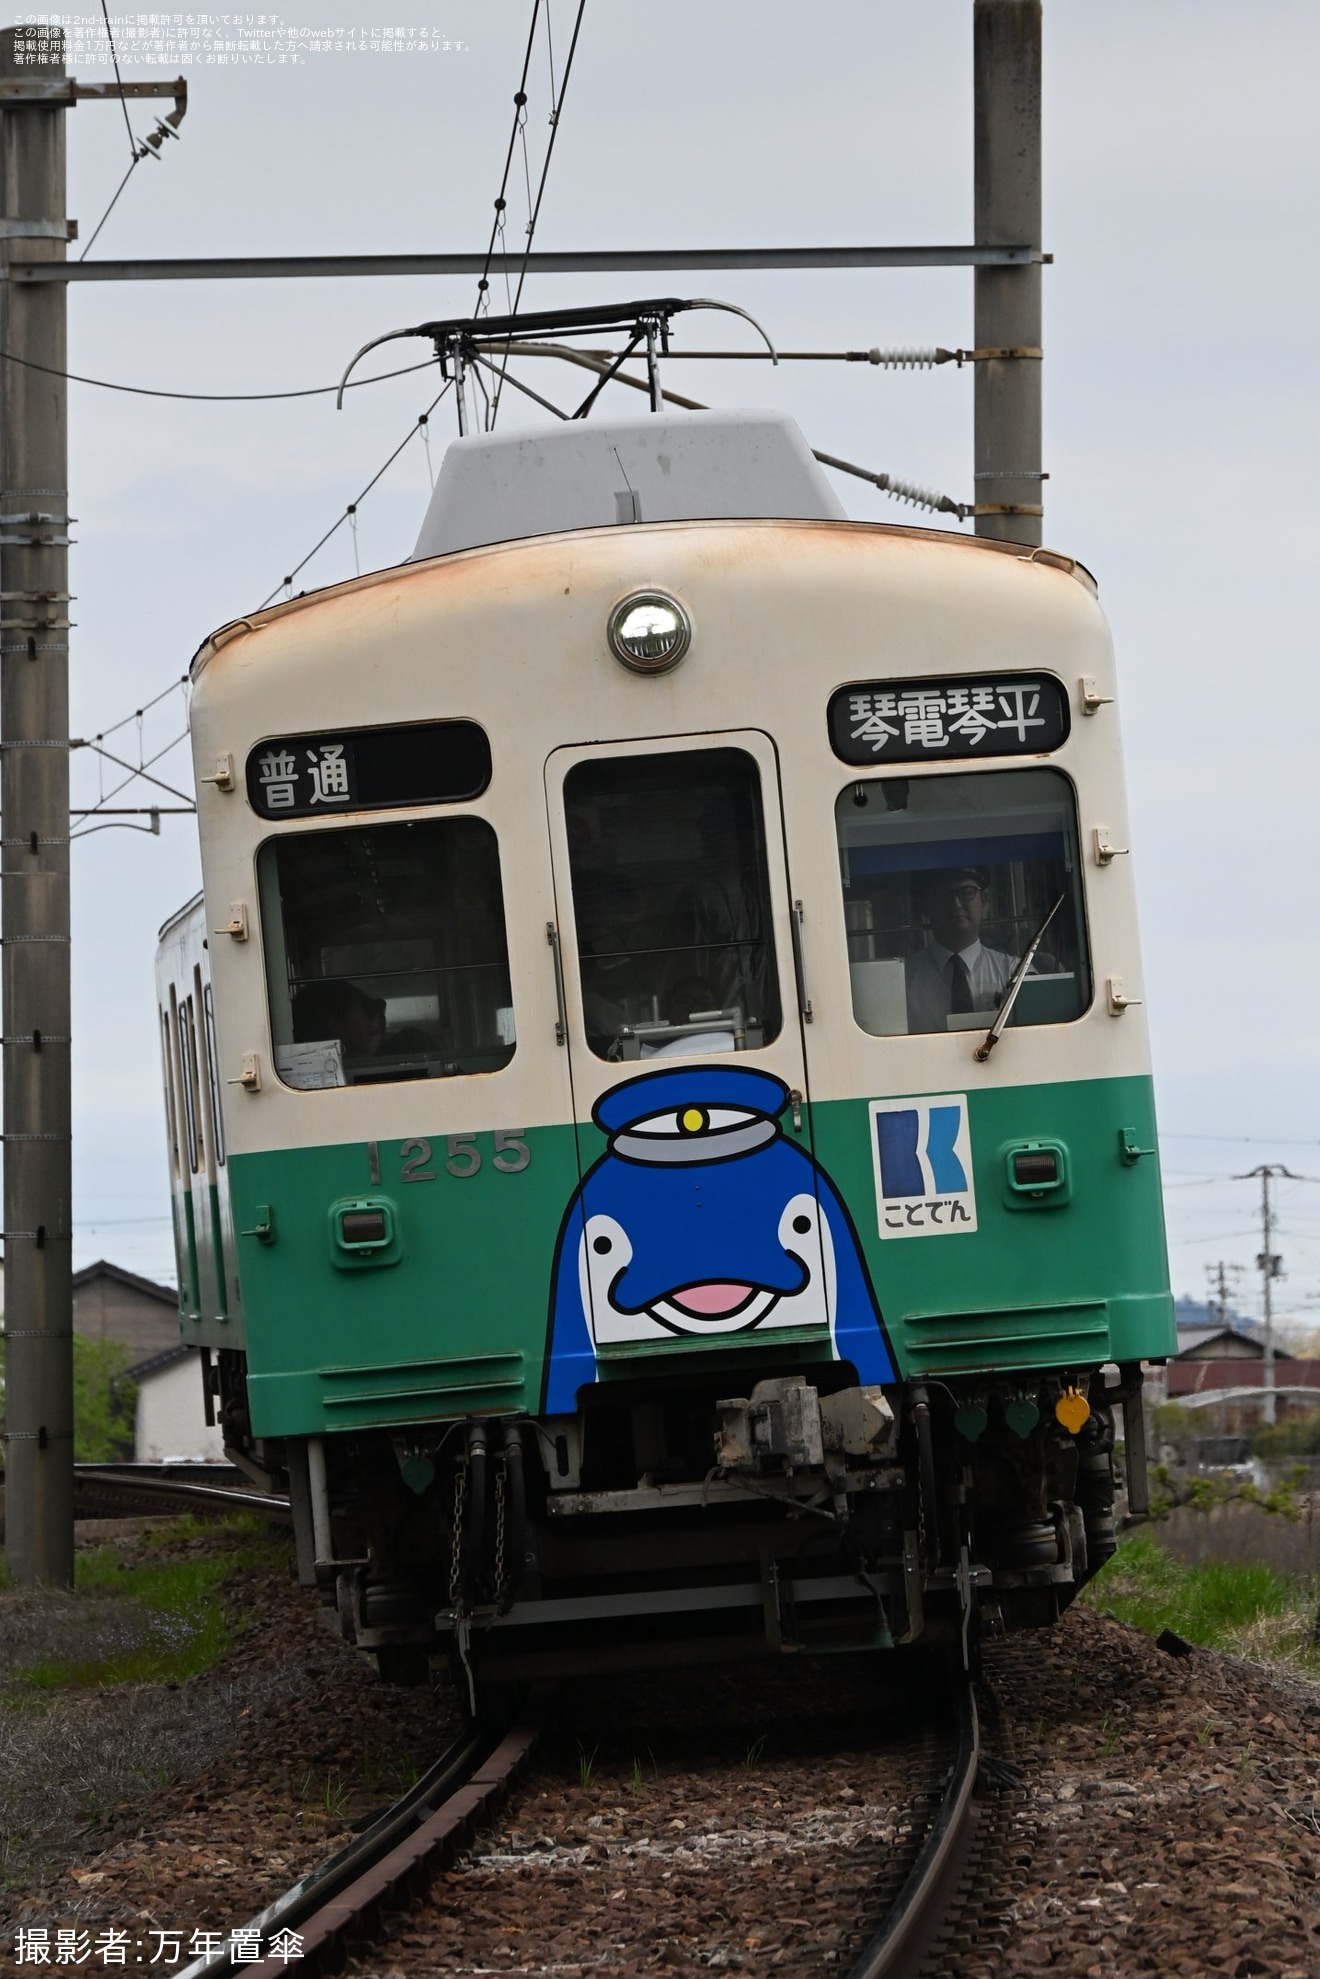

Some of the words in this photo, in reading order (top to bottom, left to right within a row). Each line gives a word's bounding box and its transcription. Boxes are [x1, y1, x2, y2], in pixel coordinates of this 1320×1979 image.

[849, 684, 1046, 752] 琴電琴平
[258, 744, 350, 809] 普通
[368, 1128, 531, 1186] 1255
[885, 1200, 971, 1228] ことでん
